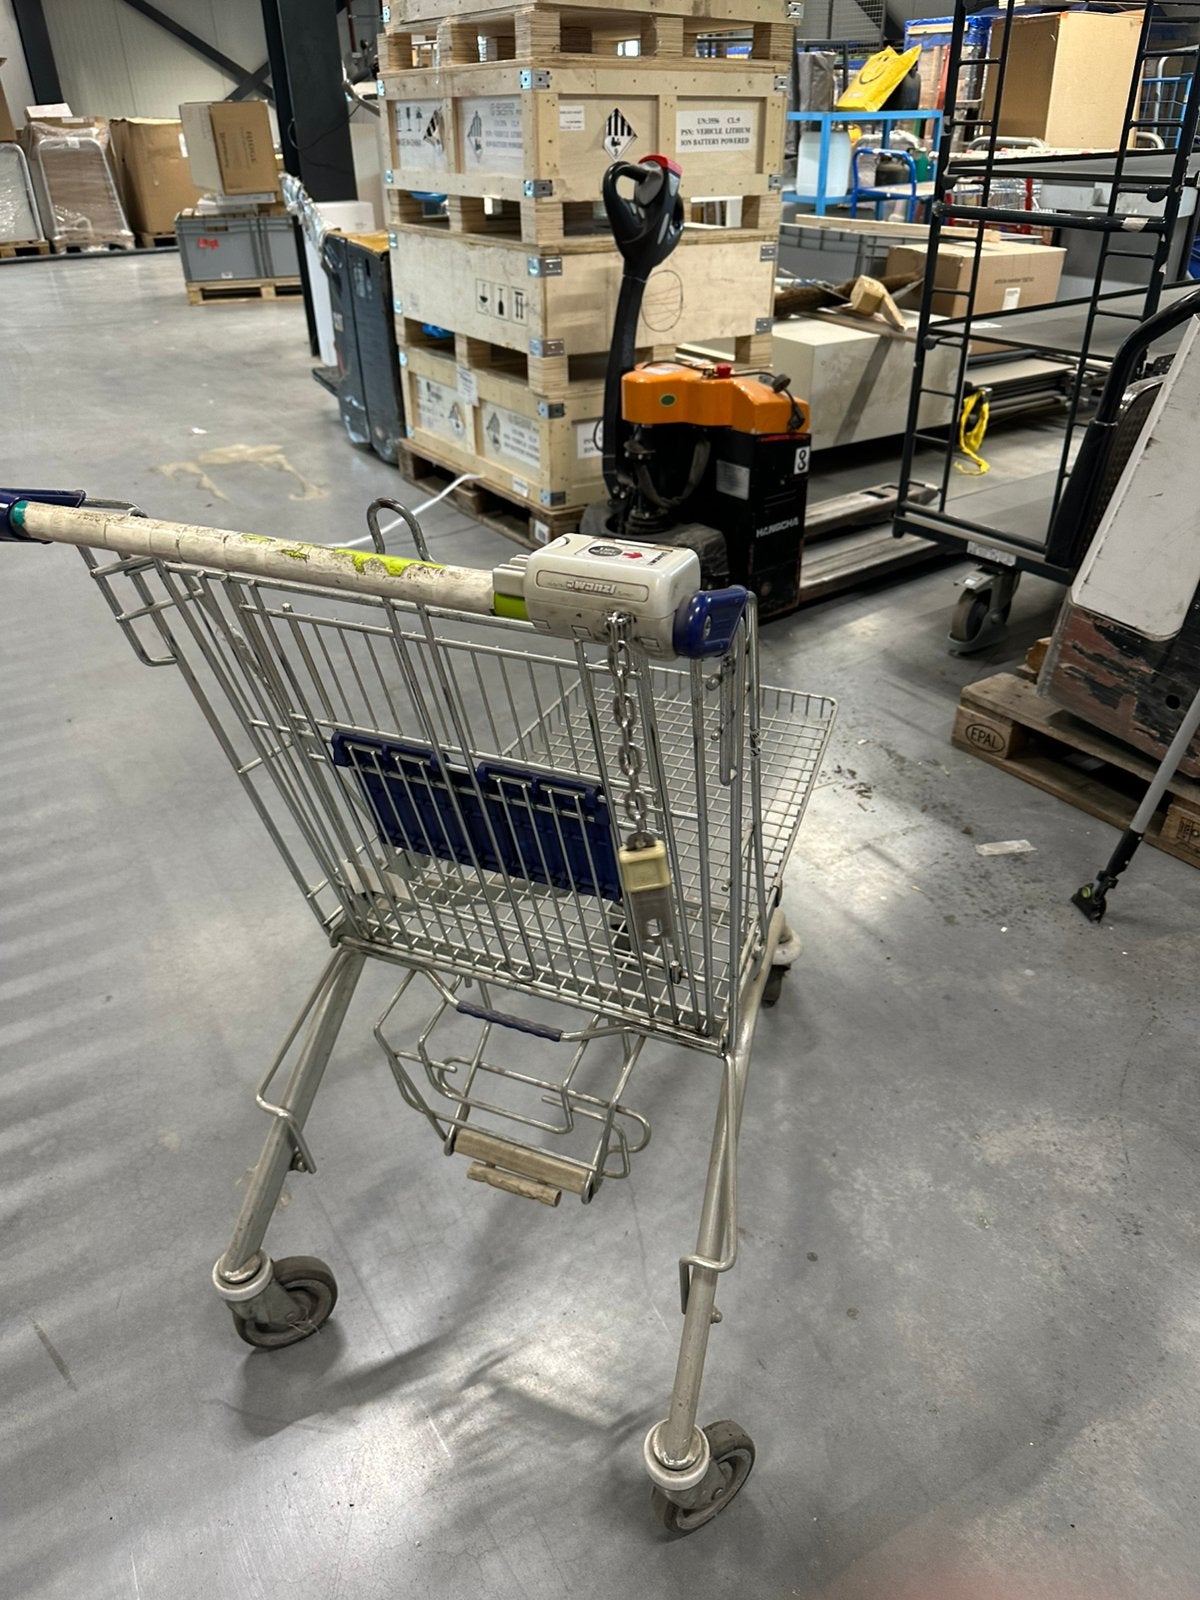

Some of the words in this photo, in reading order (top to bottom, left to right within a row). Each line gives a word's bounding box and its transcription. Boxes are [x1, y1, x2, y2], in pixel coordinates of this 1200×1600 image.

[696, 127, 722, 135] VEHICLE
[725, 126, 751, 134] LITHIUM
[693, 138, 719, 146] BATTERY
[720, 137, 750, 145] POWERED
[970, 727, 999, 750] EPAL
